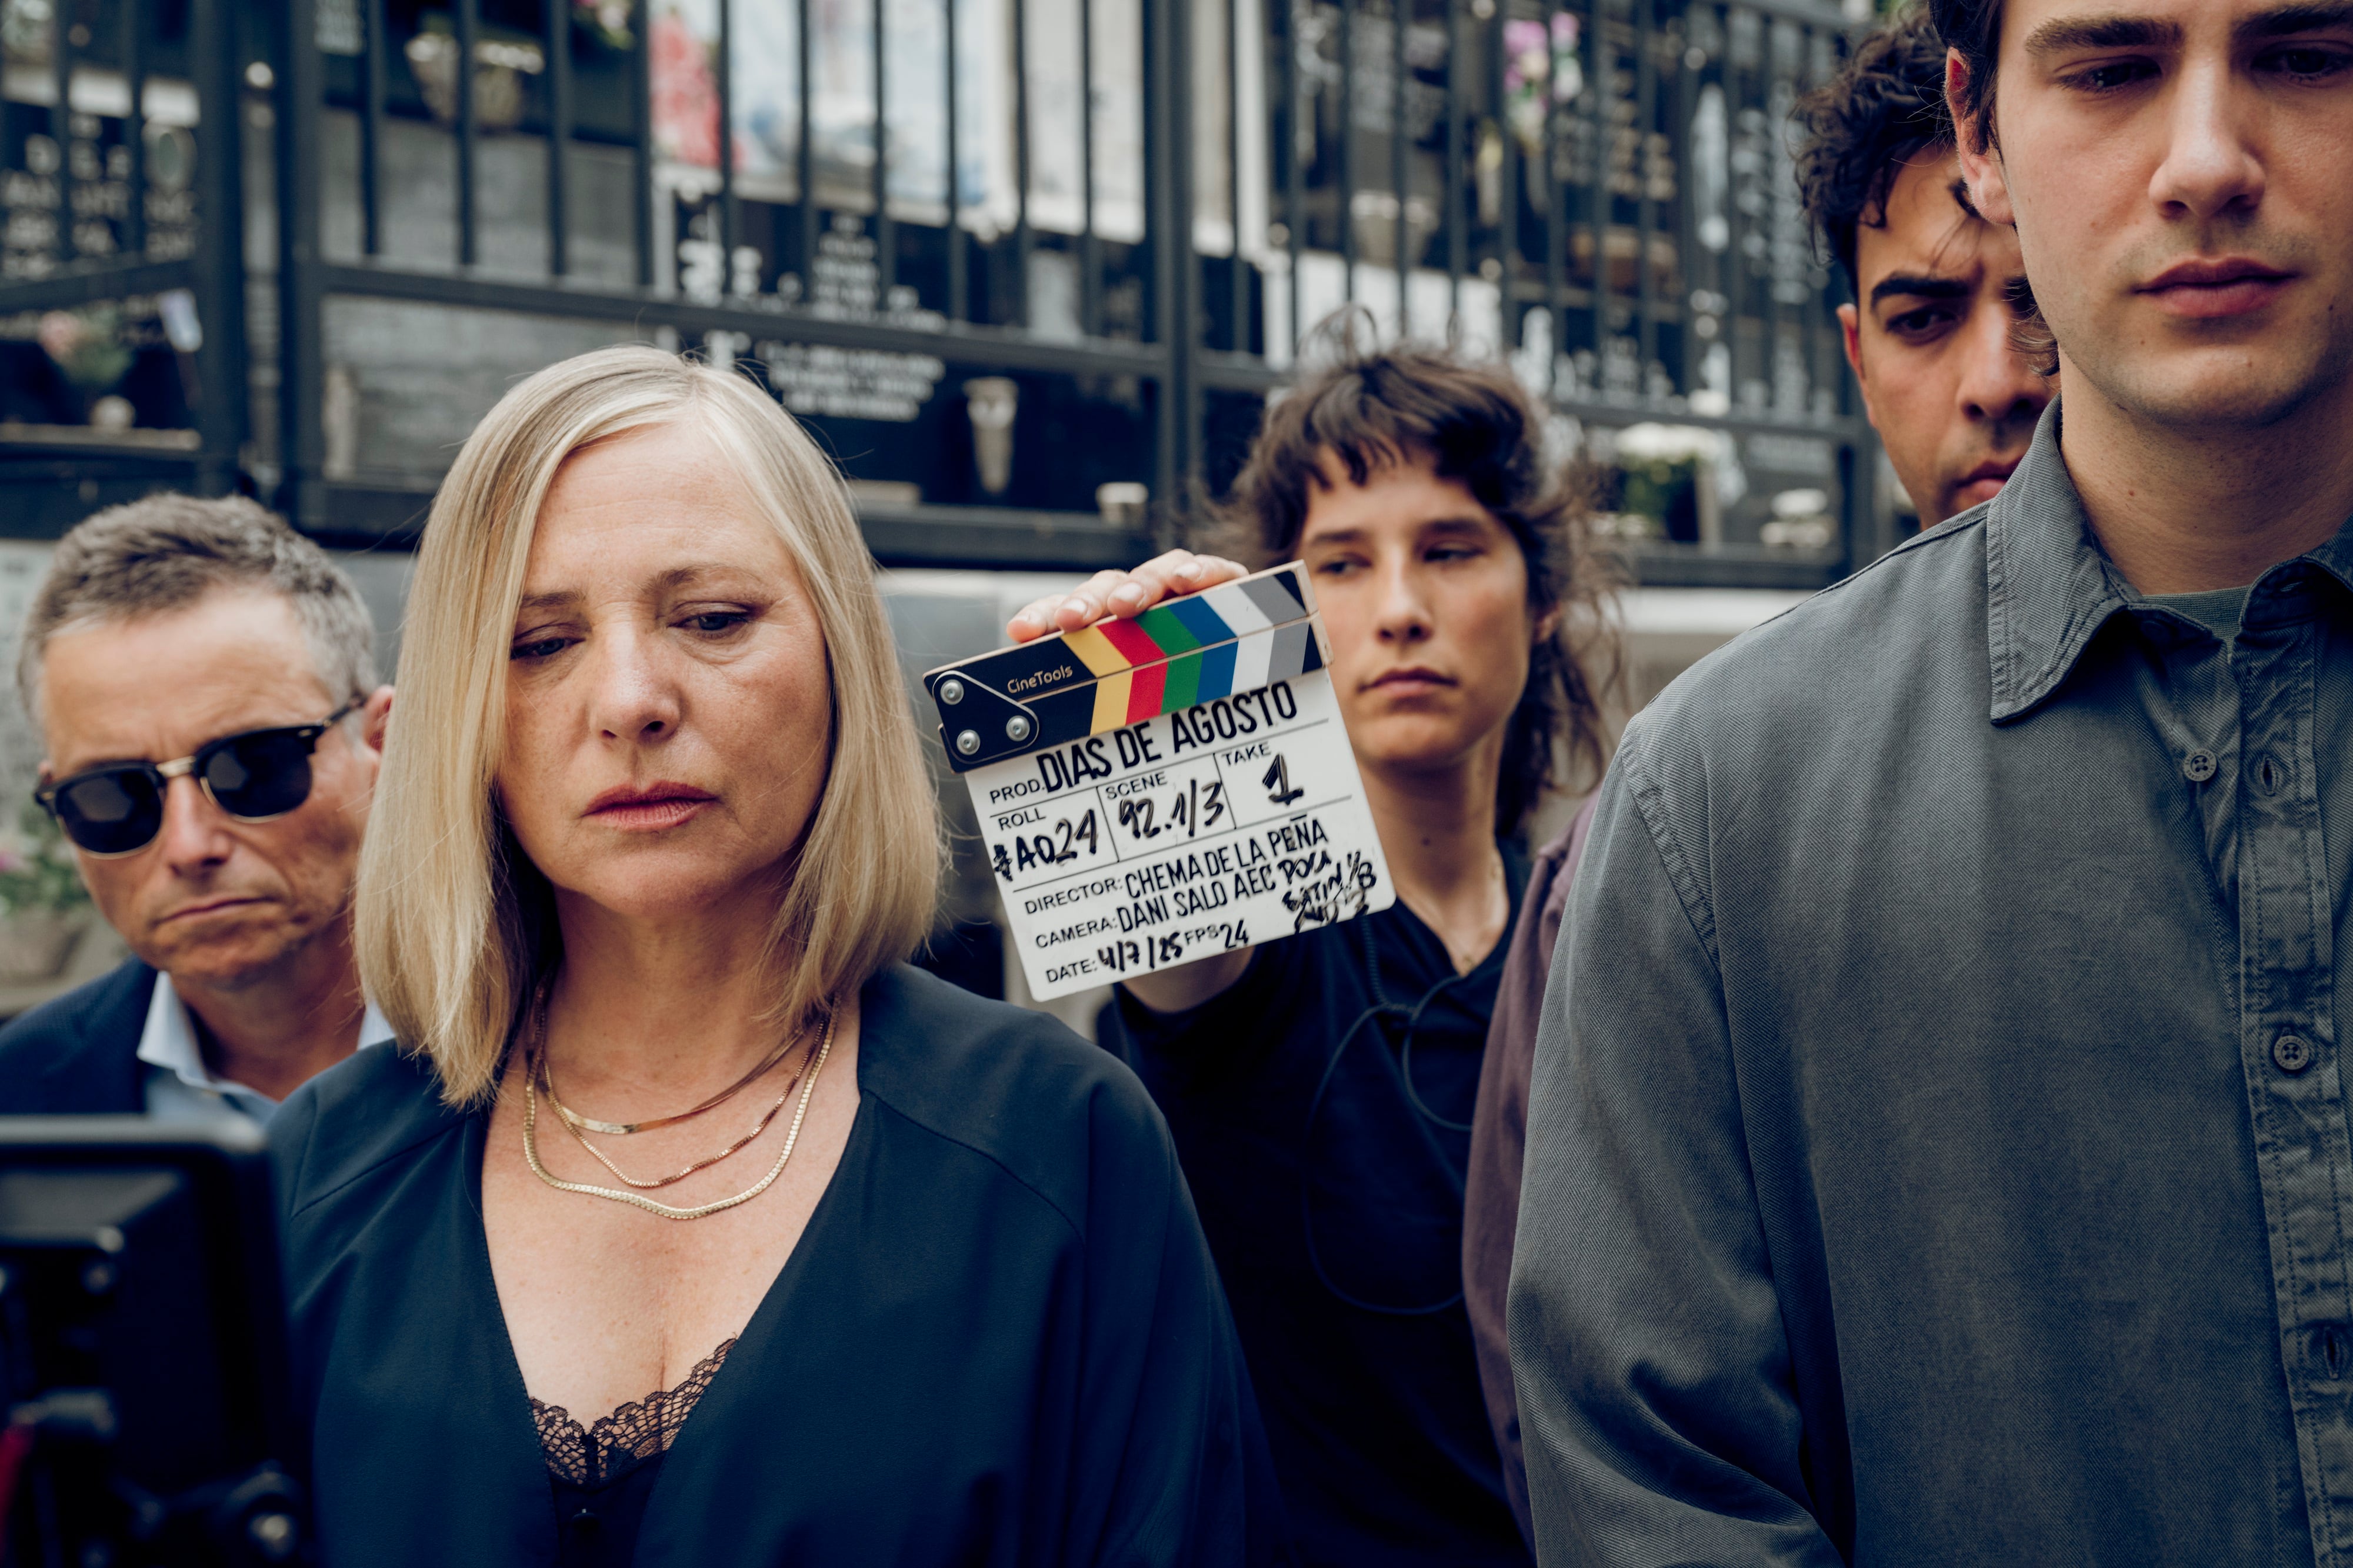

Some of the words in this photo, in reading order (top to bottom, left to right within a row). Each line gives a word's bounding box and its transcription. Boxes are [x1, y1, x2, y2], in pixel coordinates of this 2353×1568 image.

[1007, 665, 1073, 693] CineTools
[989, 778, 1045, 804] PROD.
[1036, 738, 1112, 793] DIAS
[1114, 720, 1162, 769] DE
[1171, 680, 1297, 754] AGOSTO
[1221, 741, 1272, 766] TAKE
[1105, 771, 1168, 799] SCENE
[1262, 753, 1304, 806] 1
[998, 808, 1046, 830] ROLL
[1025, 878, 1123, 915] DIRECTOR:
[1124, 854, 1204, 899] CHEMA
[1204, 846, 1233, 877] DE
[1234, 837, 1267, 868] LA
[1035, 917, 1118, 948] CAMERA:
[1116, 895, 1169, 933] DANI
[1173, 880, 1228, 918] SALO
[1234, 864, 1276, 900] AEC
[1219, 919, 1249, 951] 24
[1045, 958, 1098, 983] DATE:
